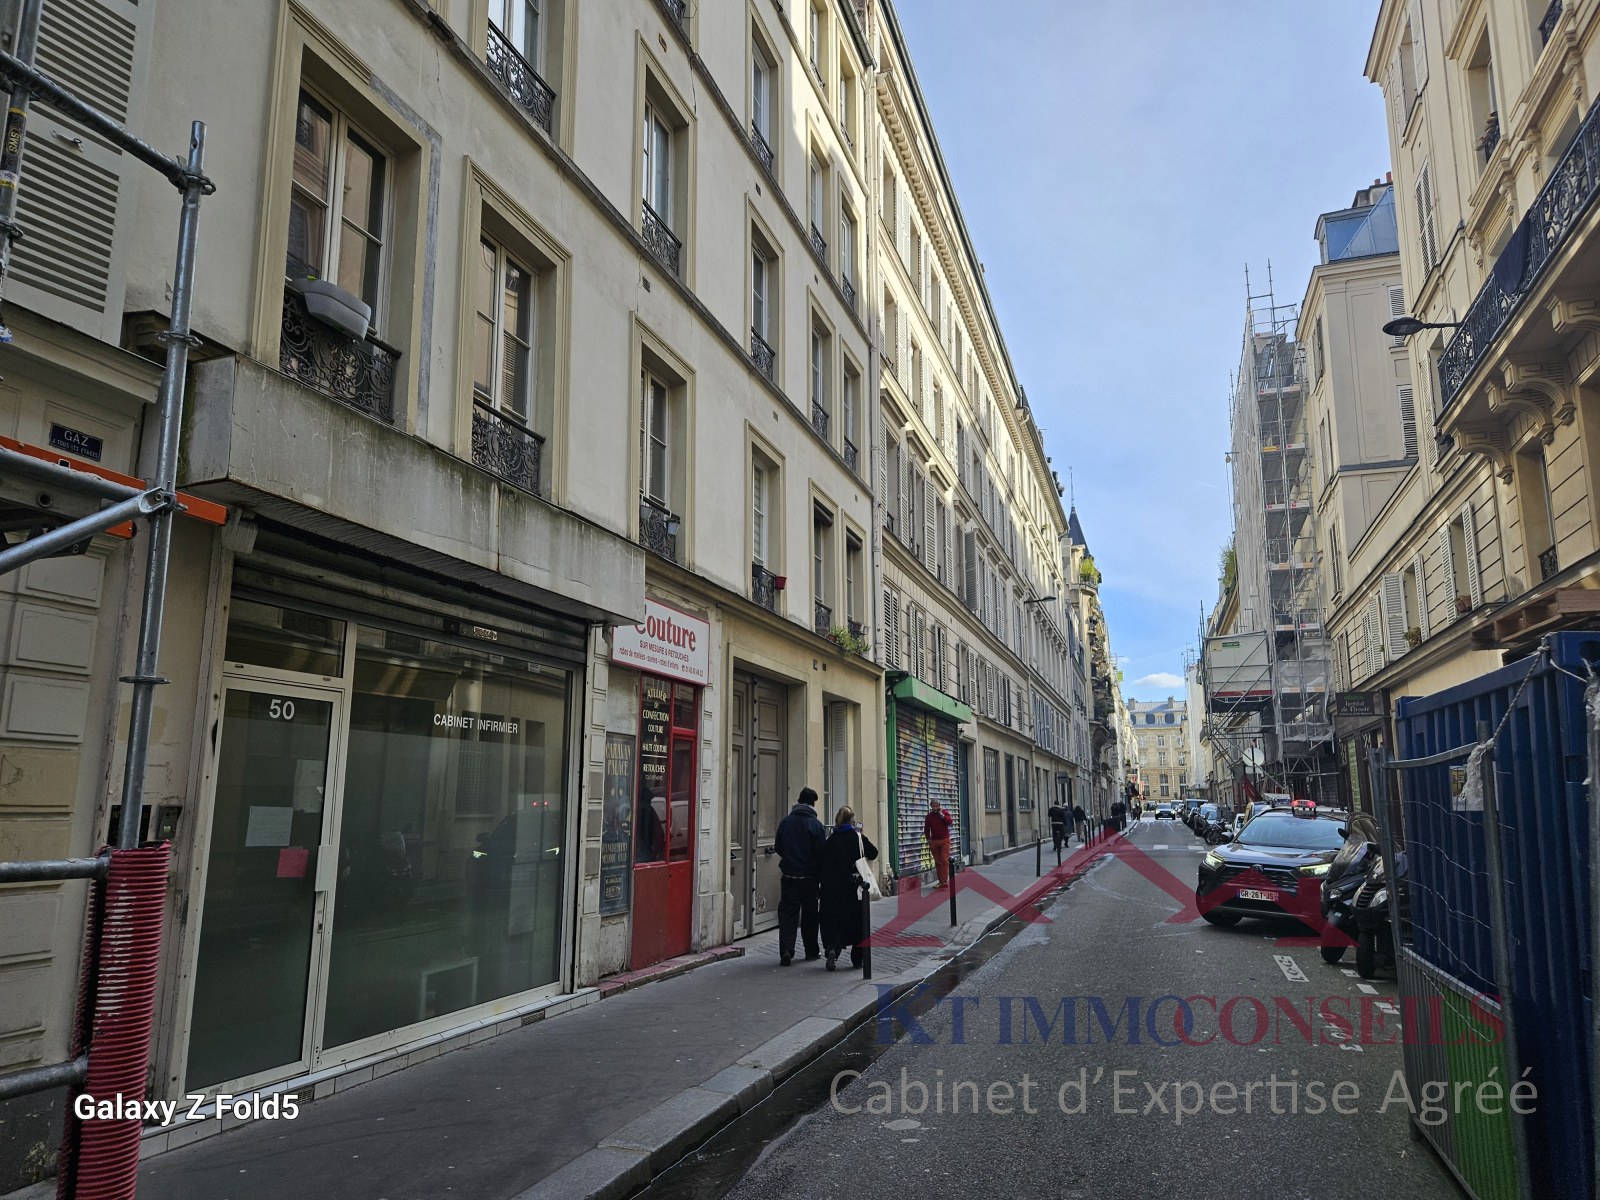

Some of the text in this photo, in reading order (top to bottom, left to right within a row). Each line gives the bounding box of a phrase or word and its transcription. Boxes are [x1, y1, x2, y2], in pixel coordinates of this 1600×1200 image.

[64, 430, 89, 447] GAZ
[640, 639, 649, 650] SUR
[648, 641, 664, 655] MESURE
[668, 648, 689, 663] RETOUCHES
[647, 688, 667, 702] ATELIER
[269, 699, 295, 720] 50
[642, 709, 670, 722] CONFECTION
[433, 713, 518, 734] CABINET INFIRMIER
[647, 723, 664, 734] COUTURE
[642, 743, 668, 753] HAUTE COUTURE
[607, 760, 629, 776] PALACE
[642, 763, 666, 773] RETOUCHES
[1240, 890, 1274, 900] GR-261-JS
